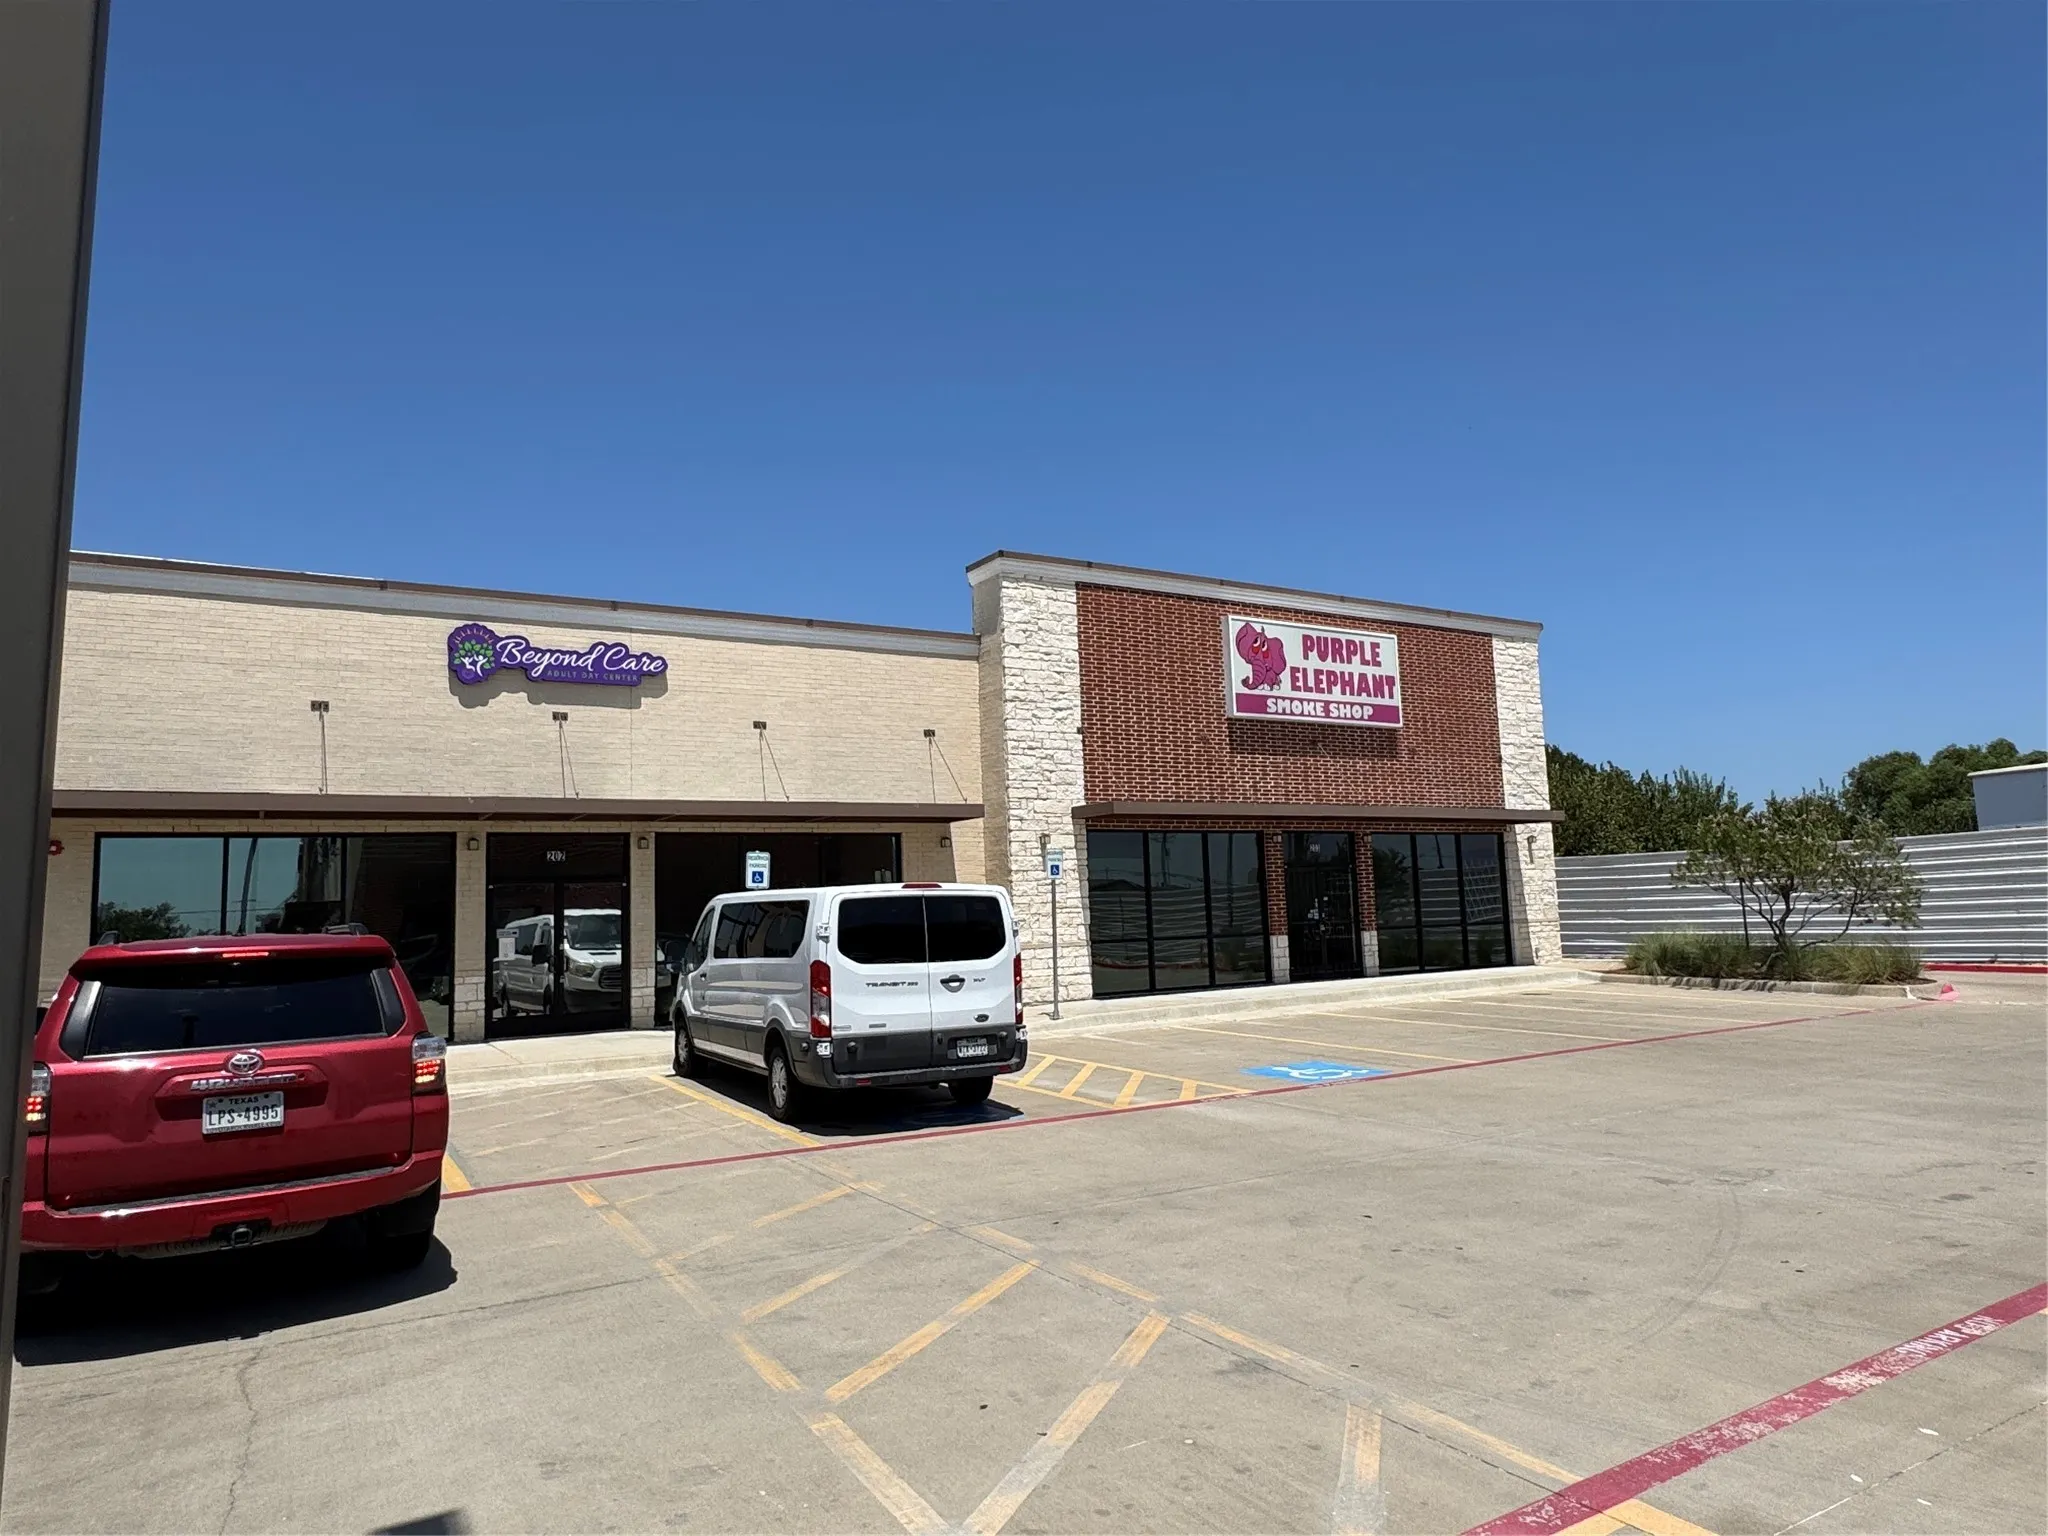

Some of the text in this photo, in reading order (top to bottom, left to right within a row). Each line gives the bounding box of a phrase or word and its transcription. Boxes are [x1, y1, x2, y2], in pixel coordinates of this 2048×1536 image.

[496, 638, 665, 678] Beyond Care
[1301, 634, 1382, 667] PURPLE
[547, 669, 639, 682] ADULT DAY CENTER
[1289, 666, 1396, 700] ELEPHANT
[1266, 698, 1373, 720] SMOKE SHOP
[547, 850, 566, 862] 202
[229, 1096, 259, 1105] TEXAS
